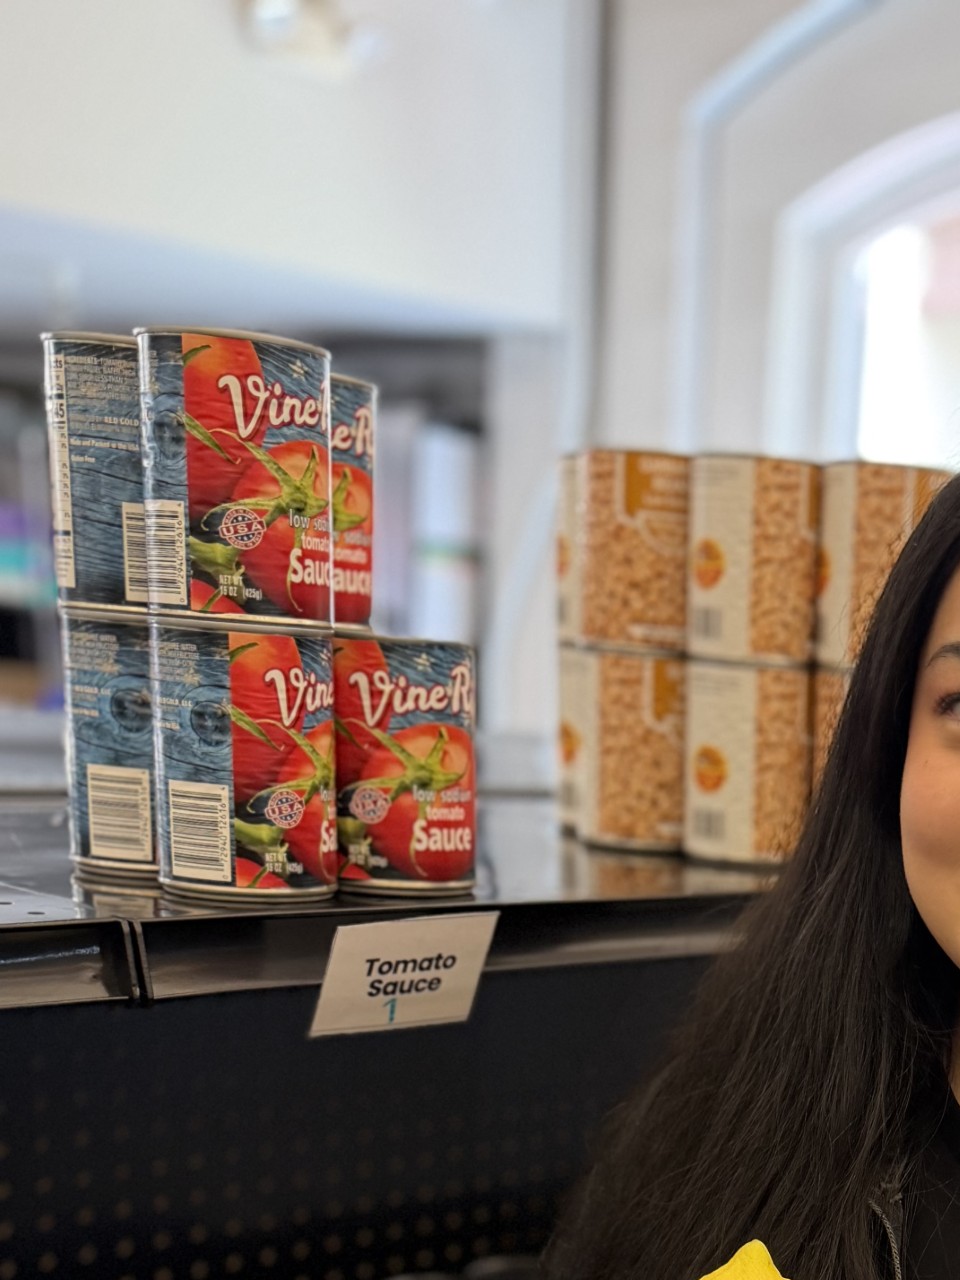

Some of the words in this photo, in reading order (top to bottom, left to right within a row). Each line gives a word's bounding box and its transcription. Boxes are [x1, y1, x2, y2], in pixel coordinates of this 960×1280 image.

[218, 374, 320, 439] Vine
[222, 520, 264, 537] USA
[289, 508, 310, 529] low
[349, 670, 448, 728] Vine
[268, 801, 303, 818] USA
[425, 804, 465, 821] tomato
[413, 818, 472, 852] Sauce
[365, 952, 457, 977] Tomato
[367, 977, 442, 997] Sauce
[382, 998, 398, 1024] 1
